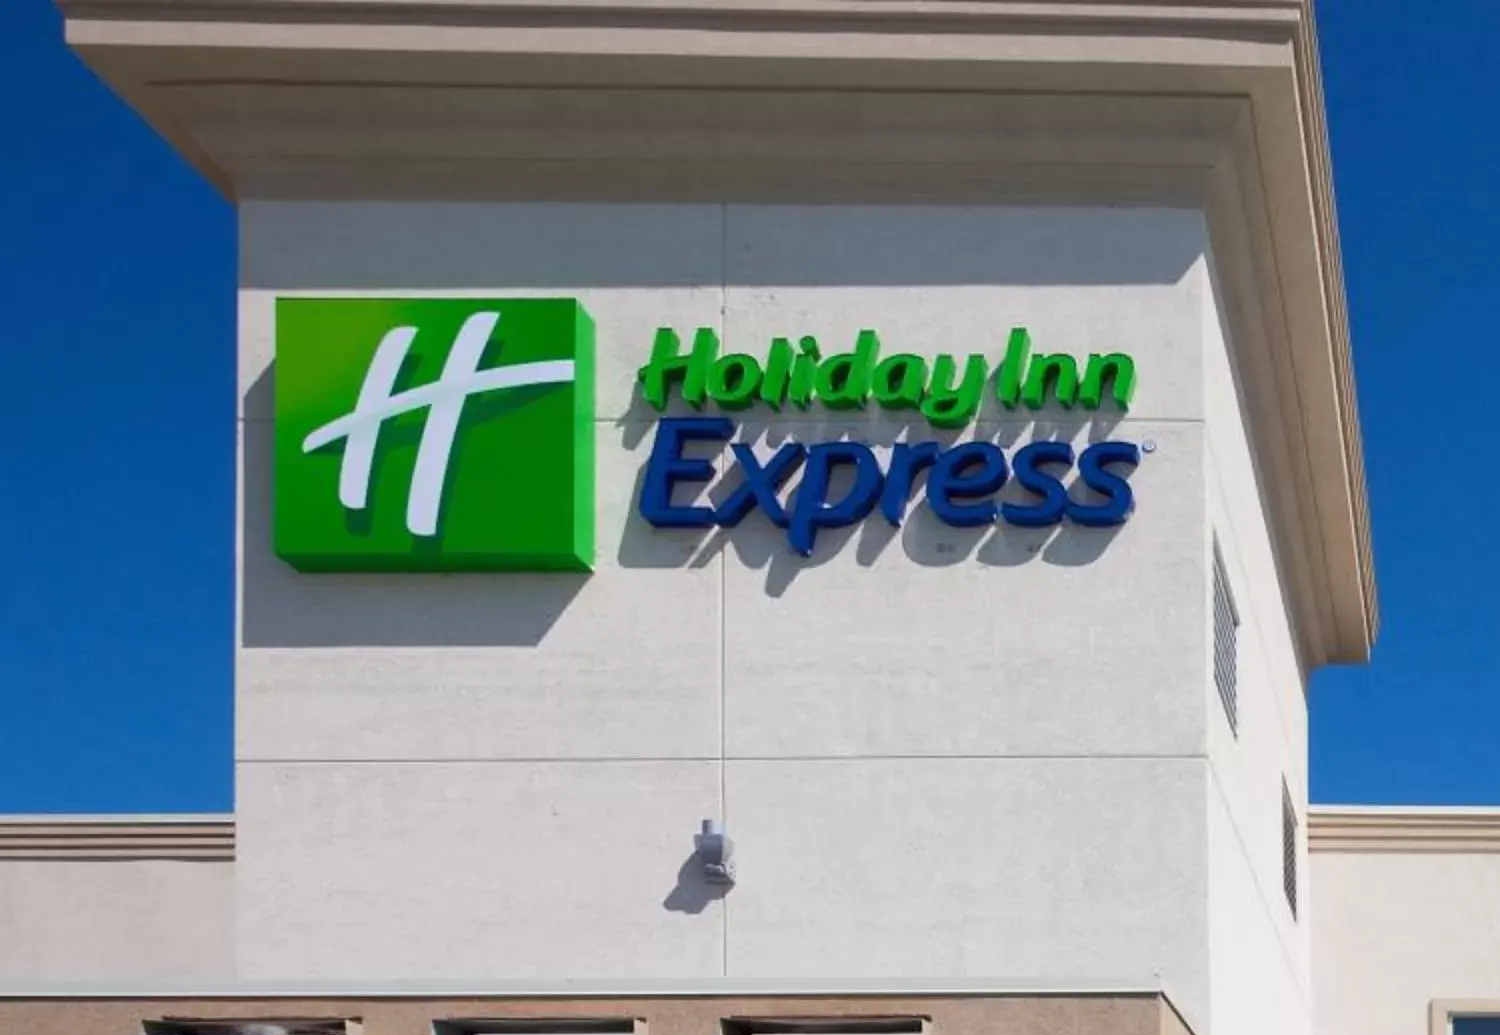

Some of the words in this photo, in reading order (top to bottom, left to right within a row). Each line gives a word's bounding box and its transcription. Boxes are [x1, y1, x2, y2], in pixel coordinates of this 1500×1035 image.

[638, 327, 989, 430] Holiday
[995, 327, 1136, 412] Inn
[639, 416, 1141, 557] Express
